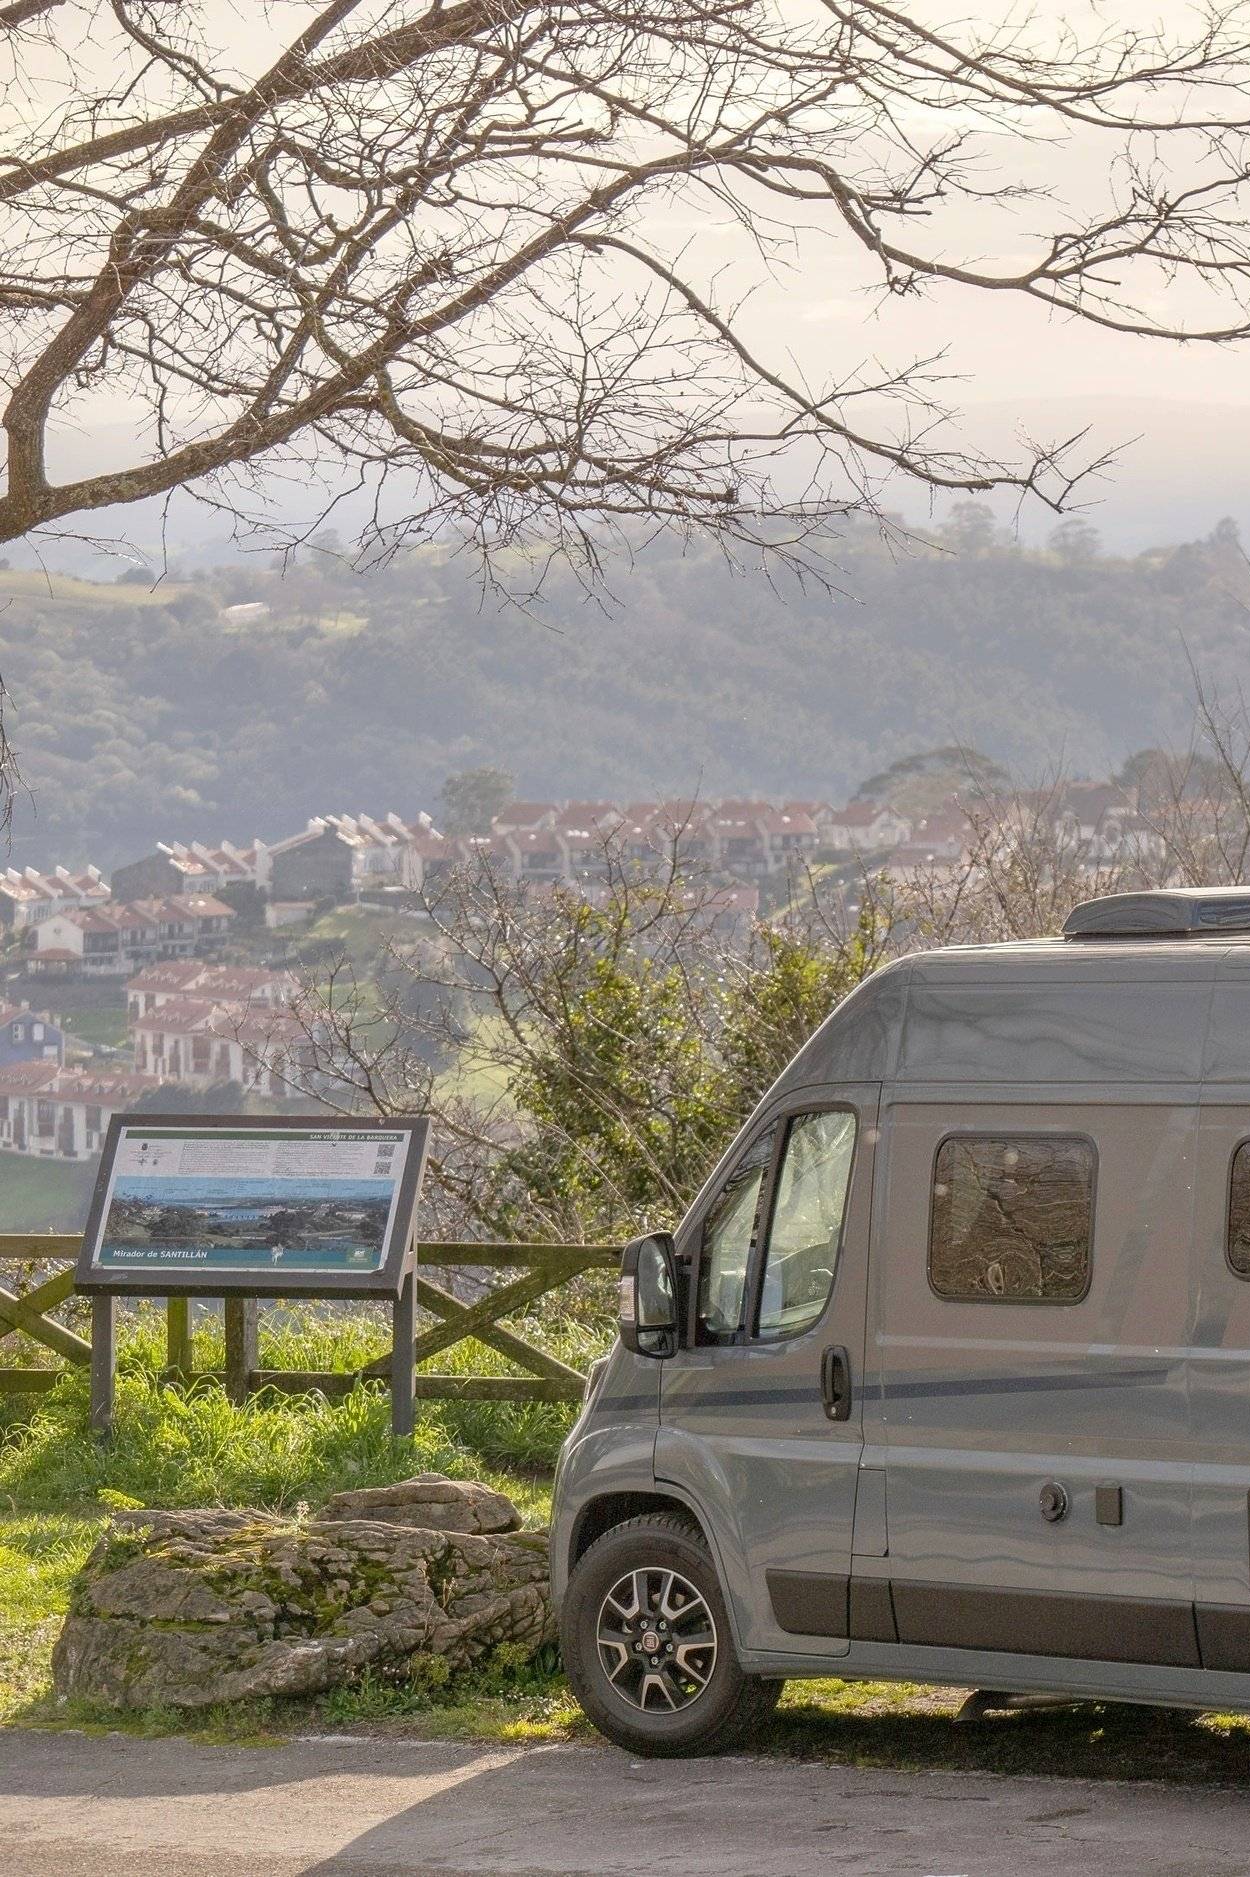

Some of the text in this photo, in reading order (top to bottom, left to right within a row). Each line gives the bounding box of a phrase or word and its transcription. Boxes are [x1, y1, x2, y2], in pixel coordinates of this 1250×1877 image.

[113, 1249, 208, 1259] Mirador de SANTILLÁN
